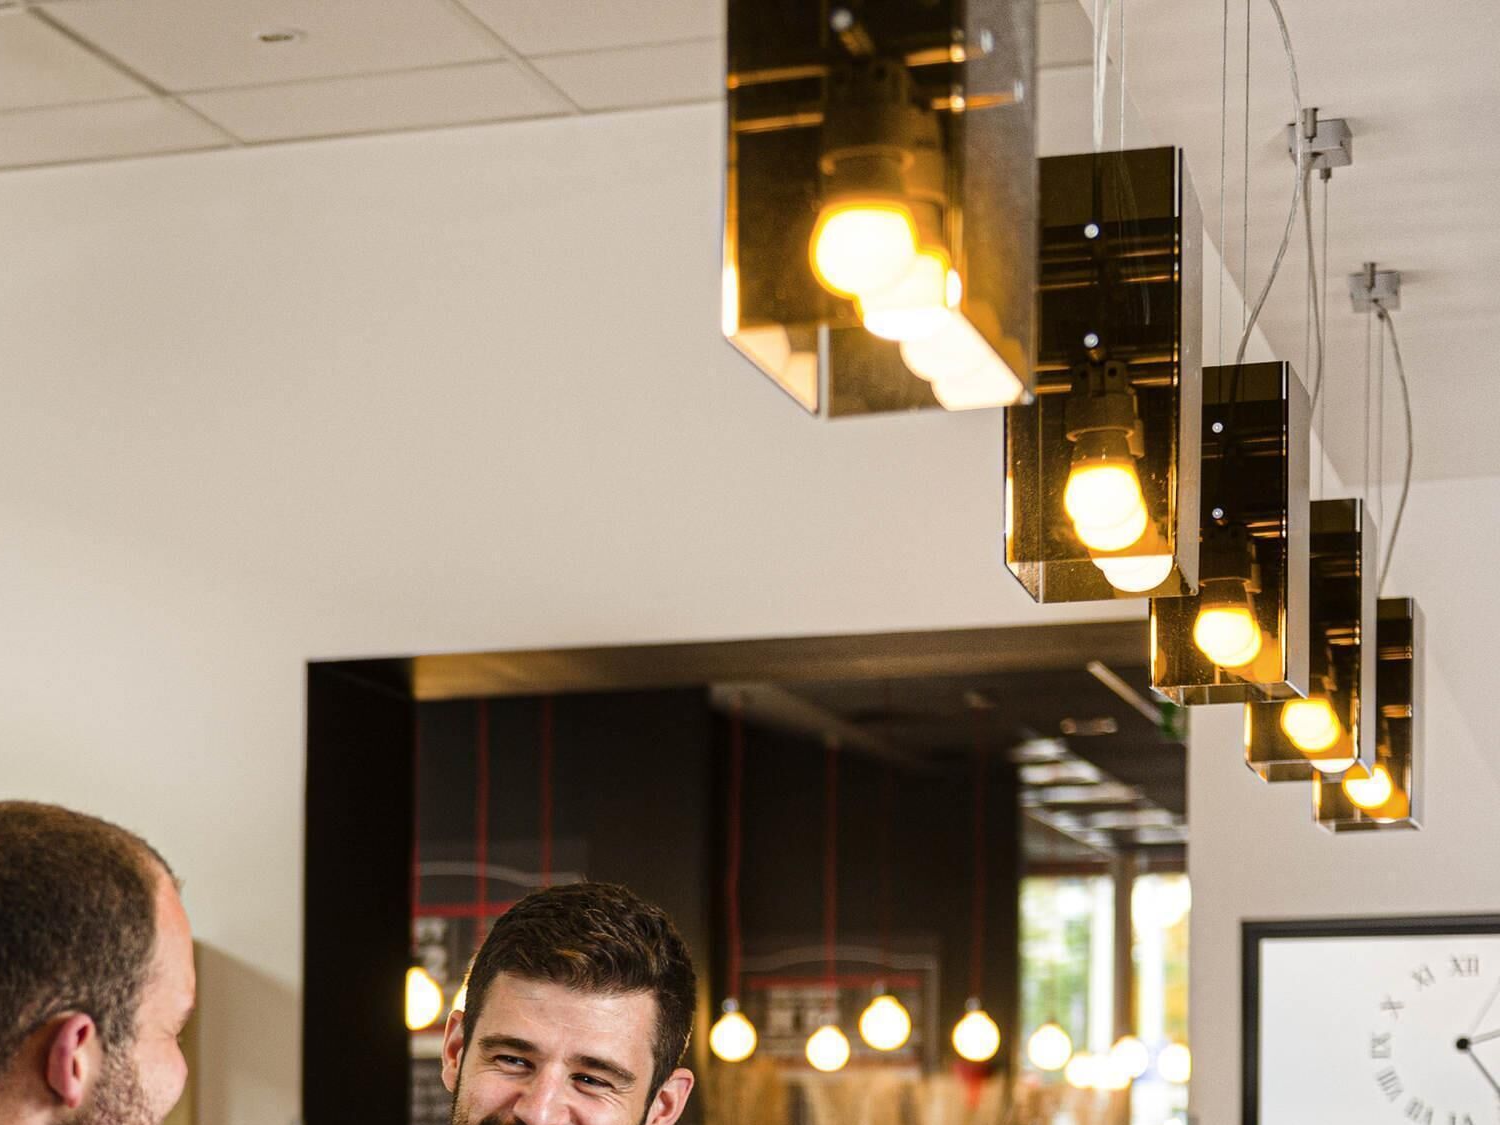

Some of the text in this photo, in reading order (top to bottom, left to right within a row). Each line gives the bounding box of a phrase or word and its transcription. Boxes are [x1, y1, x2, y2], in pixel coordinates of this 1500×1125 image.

[1411, 964, 1436, 991] XI
[1449, 954, 1480, 977] XII
[1379, 994, 1405, 1020] X
[1370, 1032, 1391, 1059] IX
[1376, 1066, 1404, 1103] VIII
